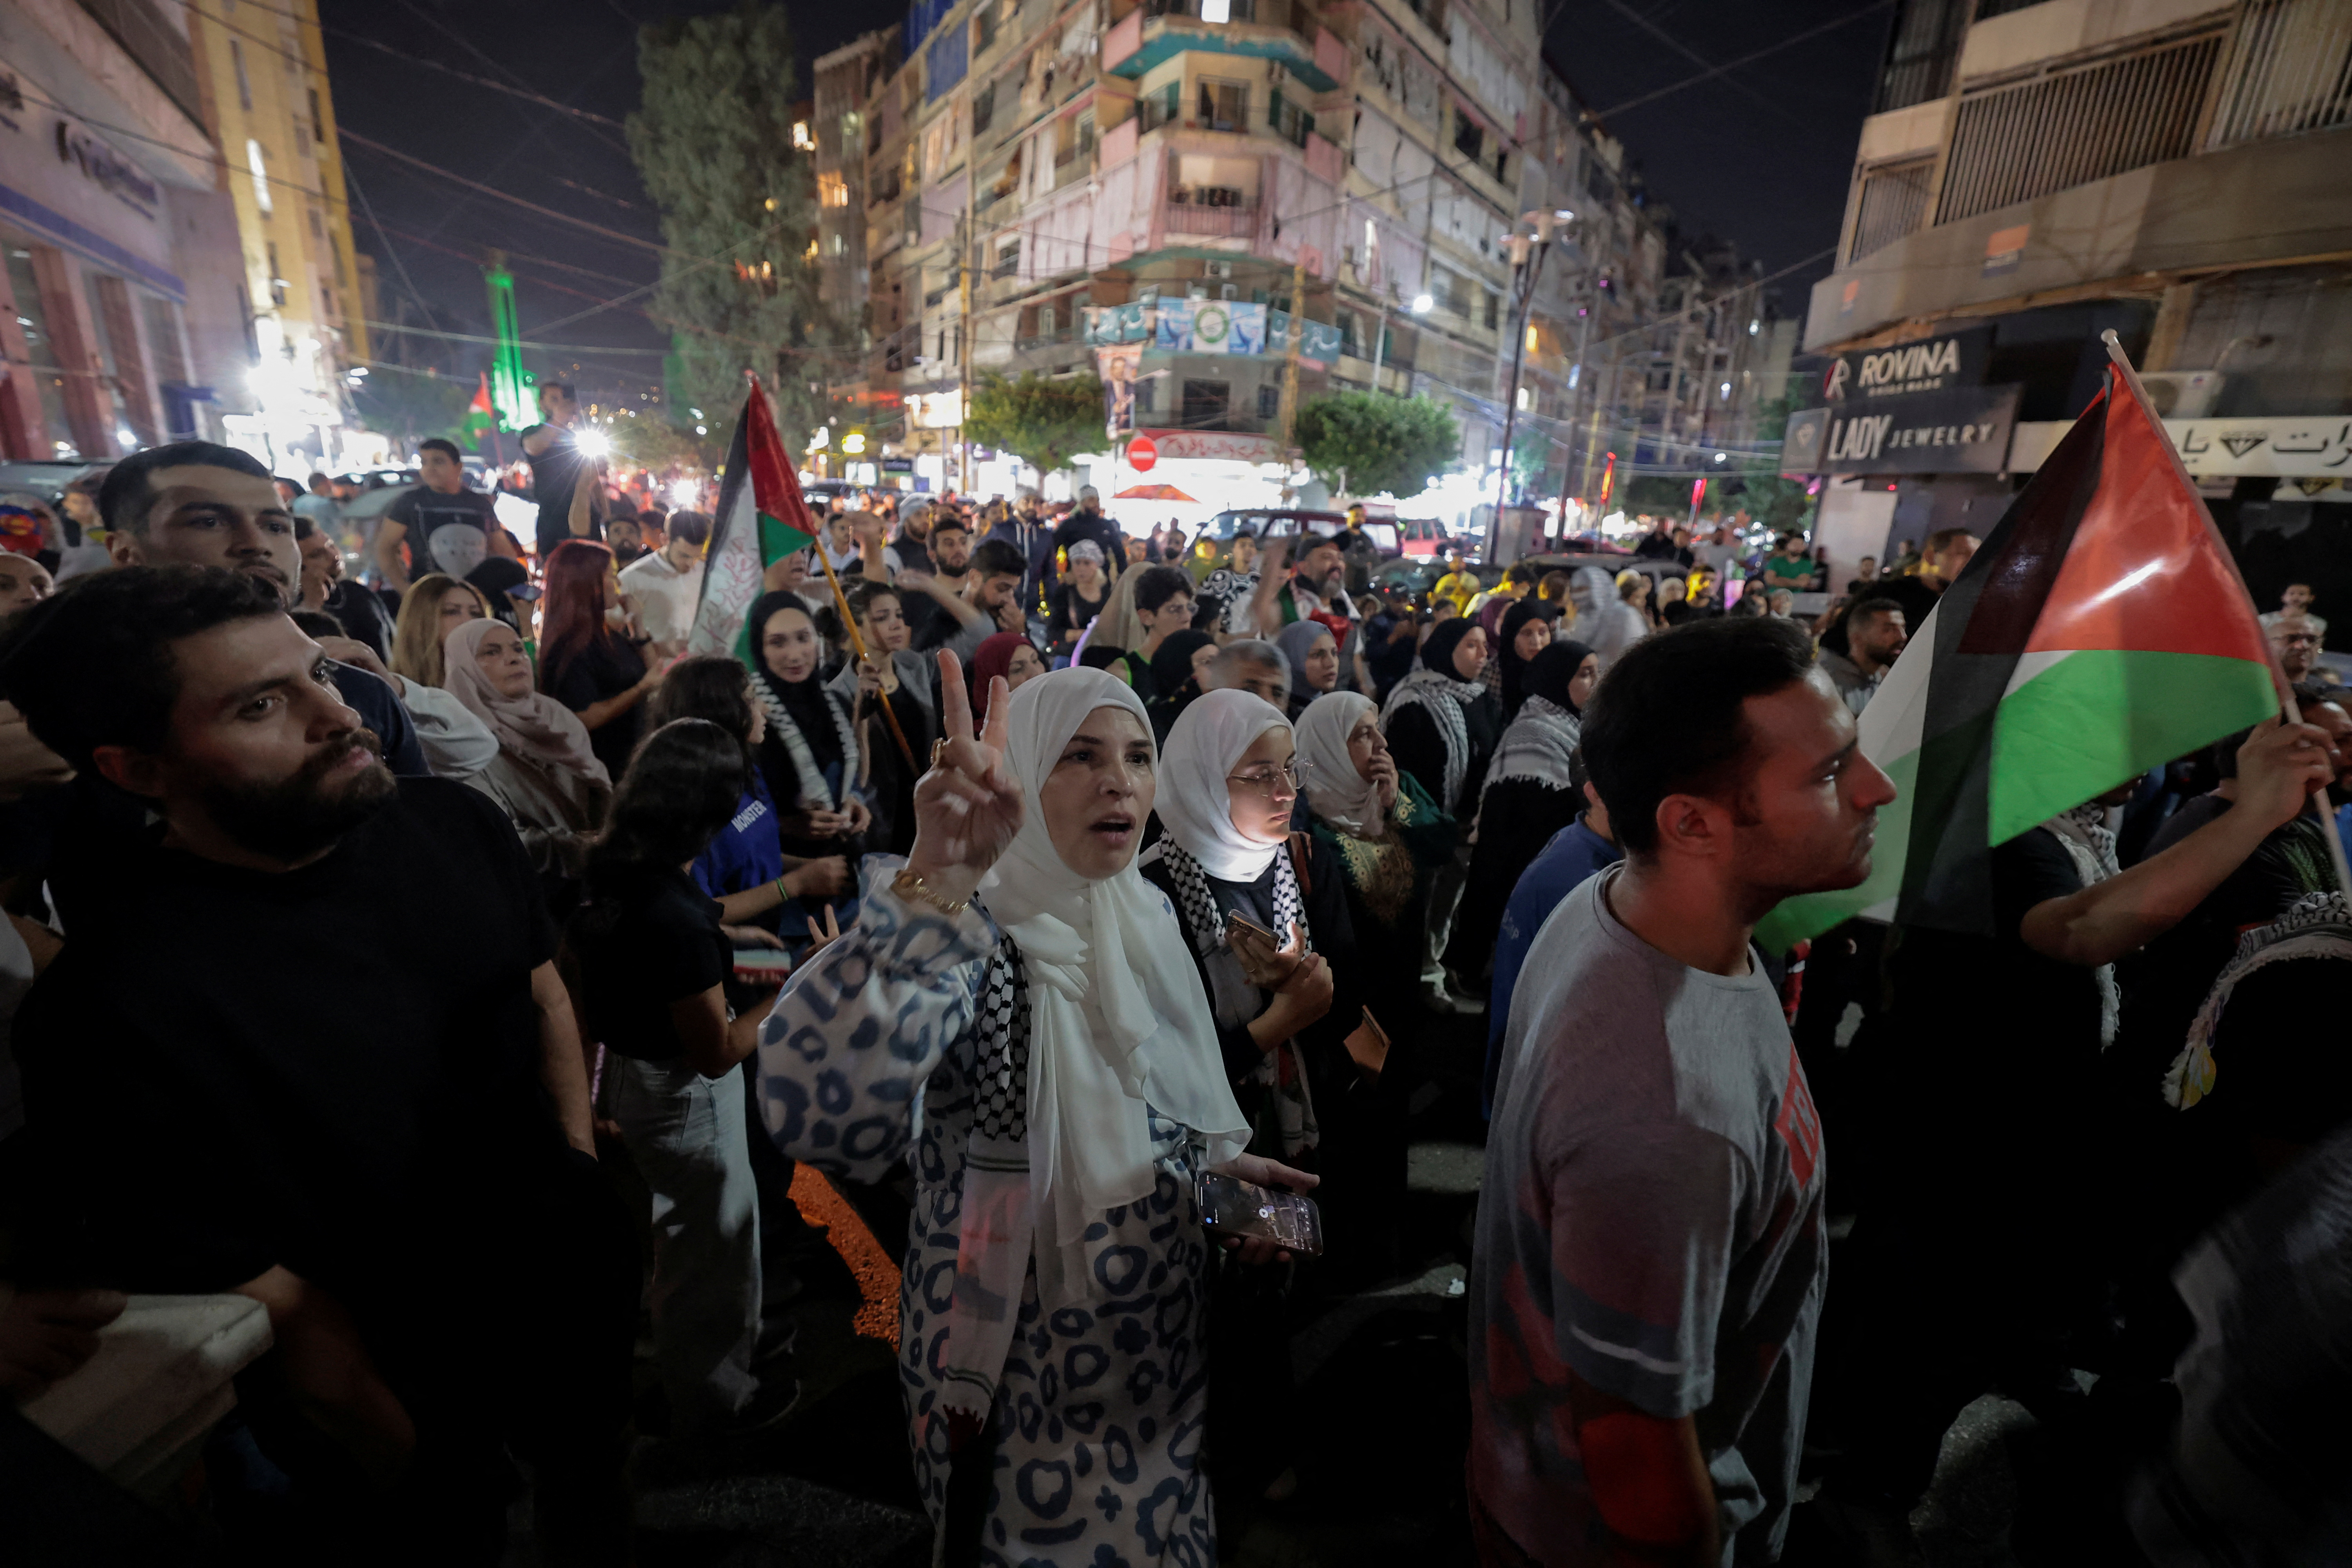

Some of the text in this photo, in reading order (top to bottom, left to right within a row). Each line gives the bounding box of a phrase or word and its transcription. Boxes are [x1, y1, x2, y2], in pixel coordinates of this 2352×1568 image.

[1858, 339, 1960, 386] ROVINA
[1828, 414, 1995, 461] LADY JEWELRY
[731, 800, 767, 833] MONSTER
